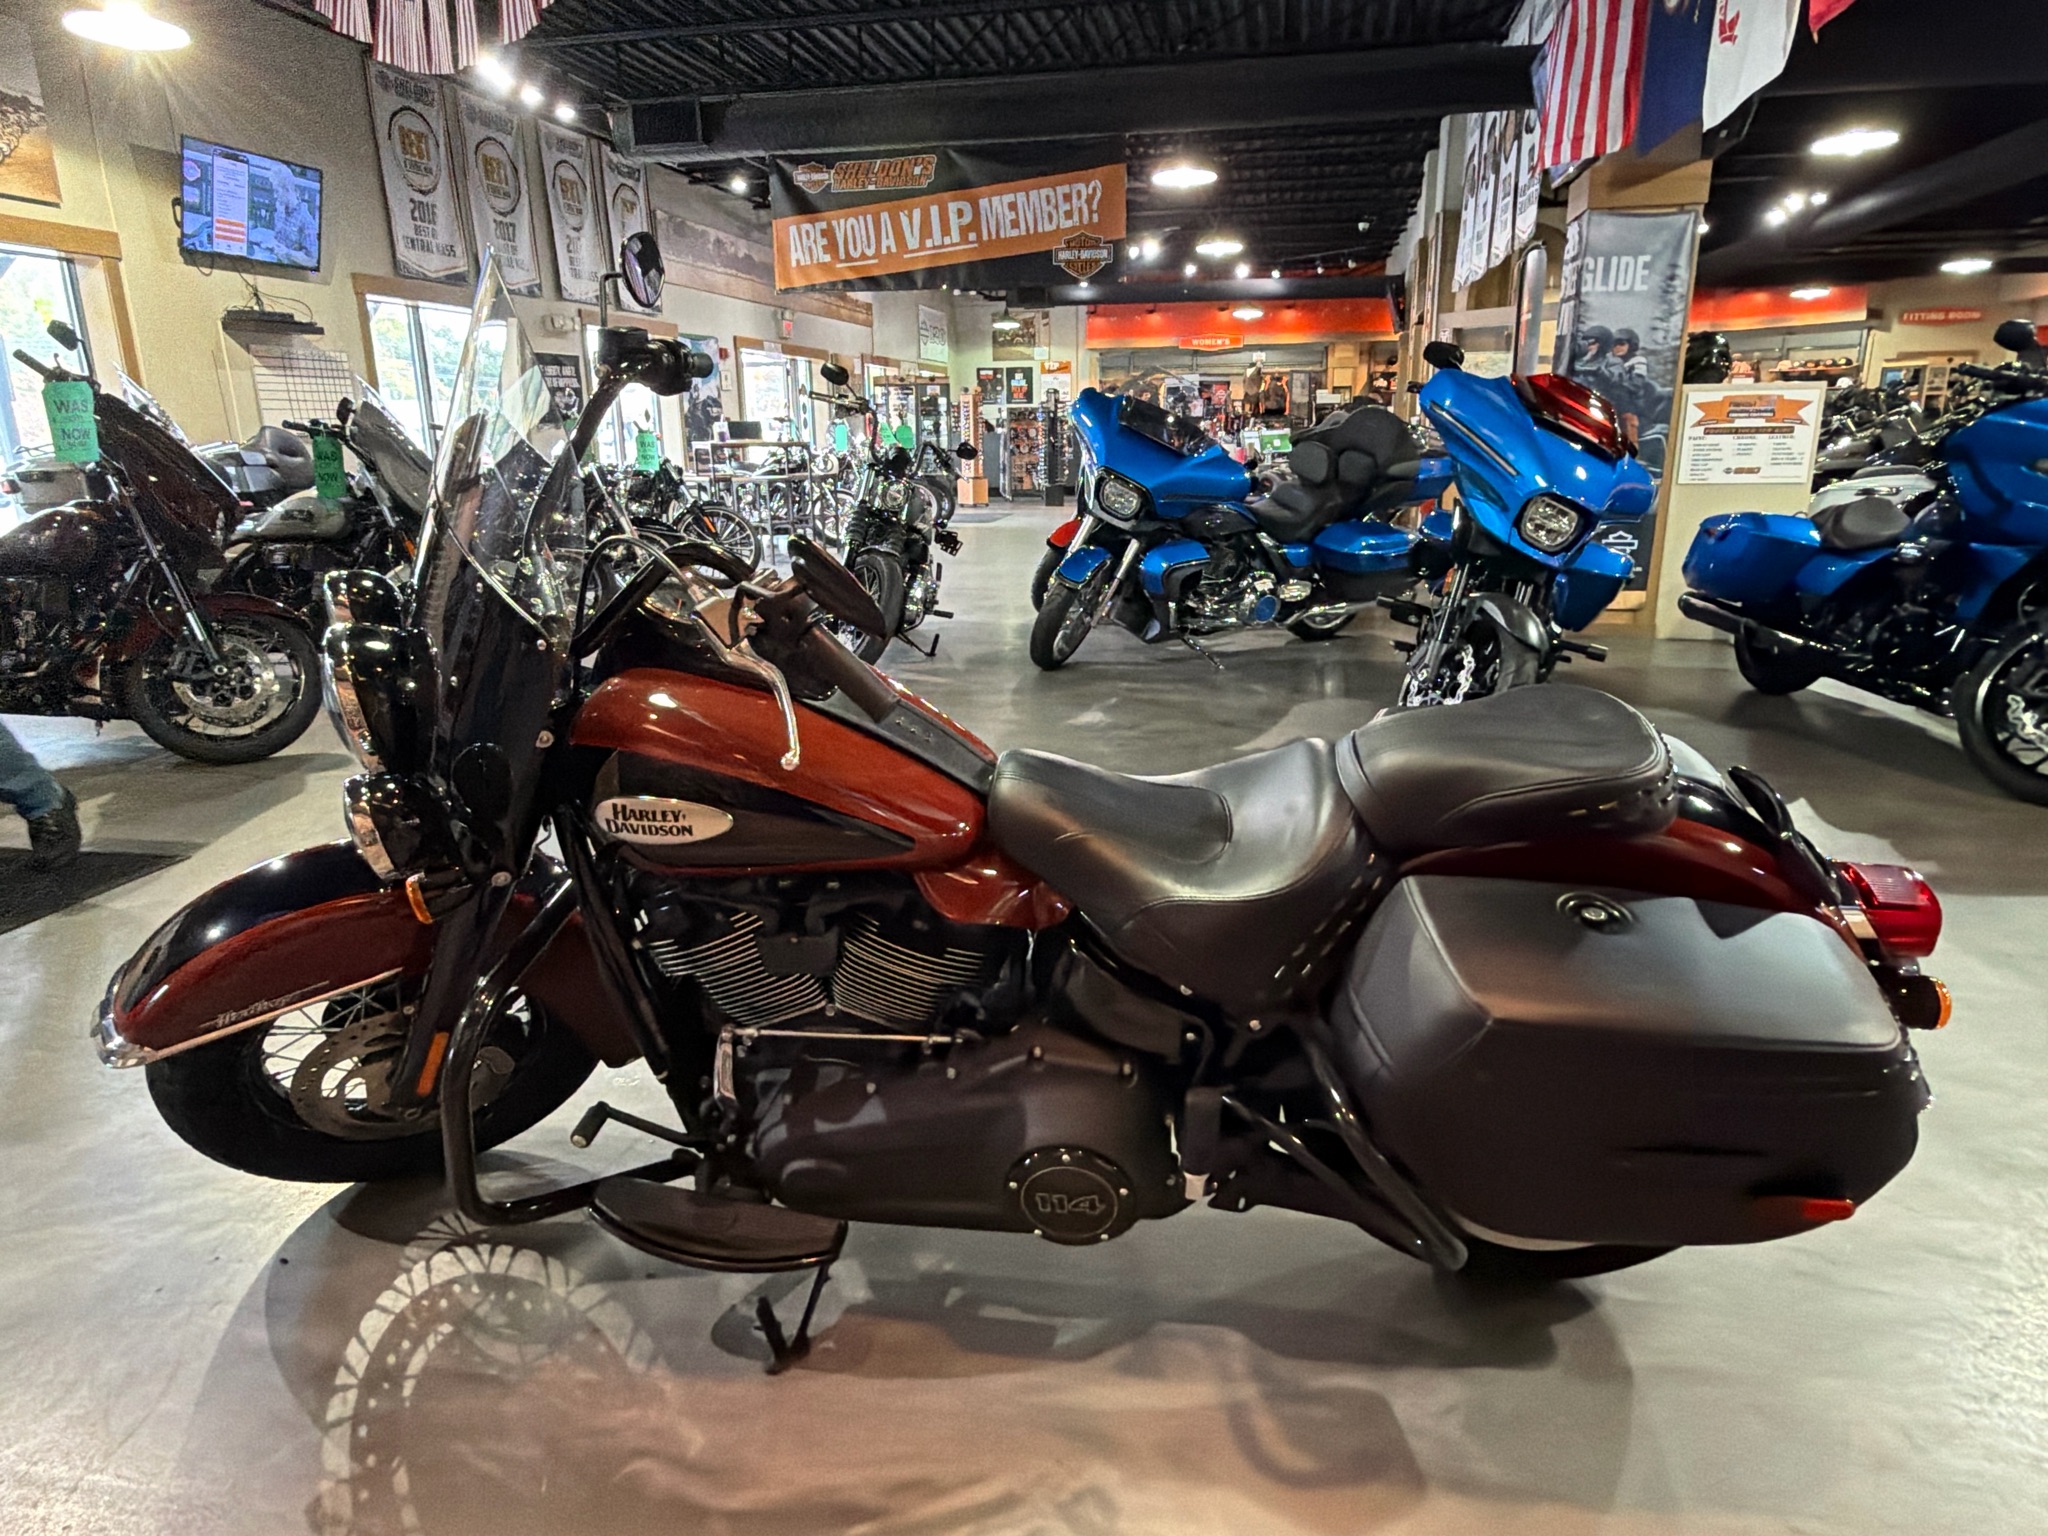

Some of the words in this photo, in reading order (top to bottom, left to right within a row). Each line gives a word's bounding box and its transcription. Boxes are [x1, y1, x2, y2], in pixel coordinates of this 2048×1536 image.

[834, 156, 935, 179] SHELDON'S
[789, 221, 832, 268] ARE
[832, 213, 876, 260] YOU
[880, 211, 898, 255] A
[899, 201, 976, 250] V.I.P.
[979, 179, 1103, 241] MEMBER?
[1057, 248, 1109, 260] HARLEY-DAVIDSON
[1582, 255, 1651, 293] GLIDE
[1191, 338, 1230, 346] WOMEN'S
[53, 400, 89, 414] WAS
[60, 428, 91, 441] NOW
[639, 440, 656, 448] WAS
[605, 818, 694, 836] DAVIDSON
[1035, 1193, 1106, 1215] 114
